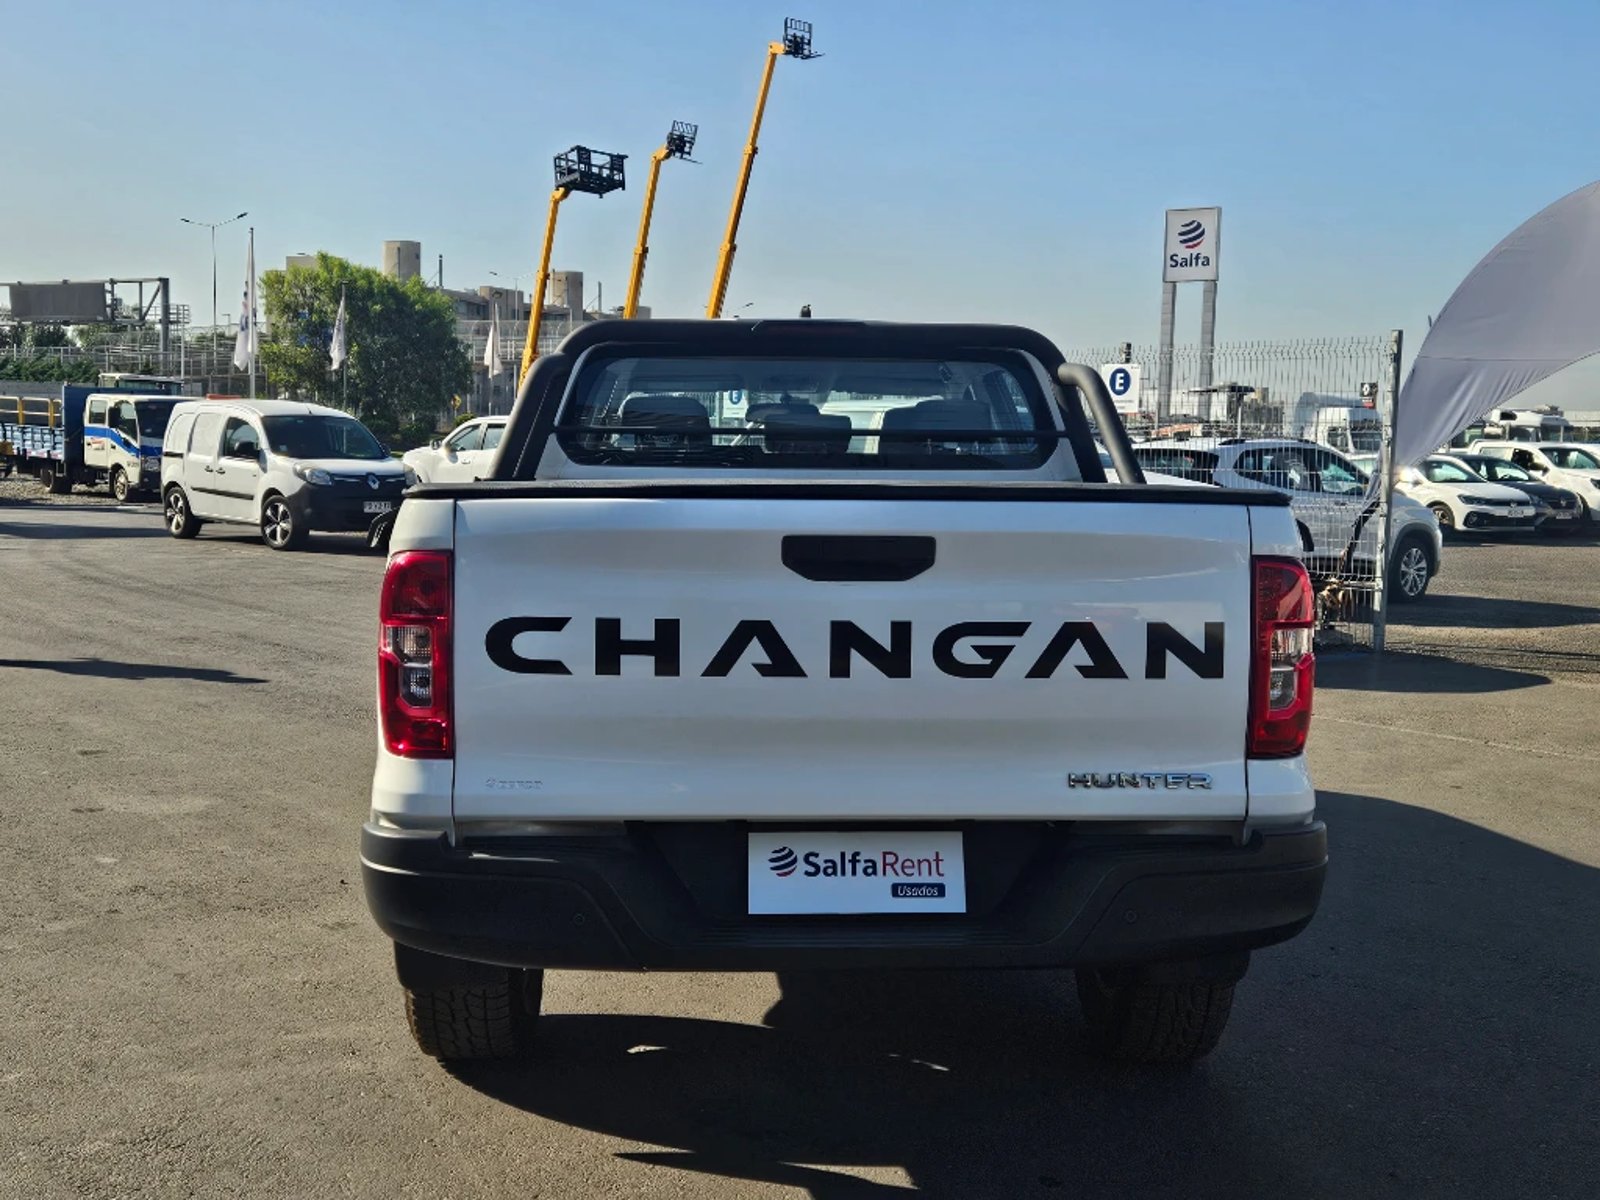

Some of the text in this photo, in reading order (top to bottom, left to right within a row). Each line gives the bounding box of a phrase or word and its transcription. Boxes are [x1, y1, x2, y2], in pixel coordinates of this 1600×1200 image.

[1169, 252, 1211, 268] Salfa
[1115, 373, 1125, 390] E
[732, 390, 739, 402] E
[485, 616, 1225, 679] CHANGAN
[1067, 772, 1214, 790] HUNTER
[897, 885, 939, 897] Usados
